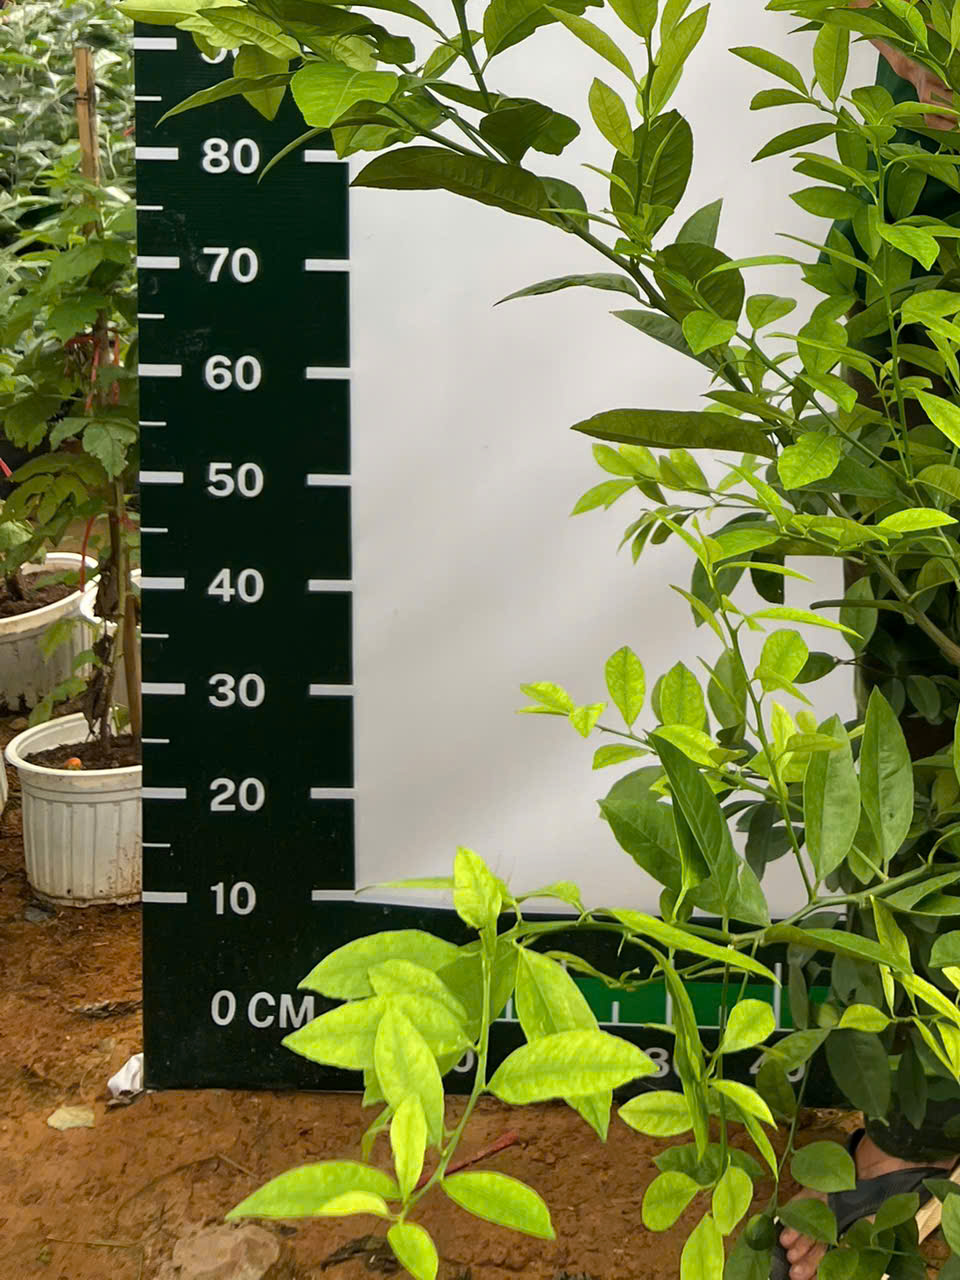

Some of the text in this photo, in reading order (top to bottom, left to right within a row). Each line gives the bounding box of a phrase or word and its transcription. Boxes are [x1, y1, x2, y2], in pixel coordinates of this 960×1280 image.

[203, 138, 259, 173] 80
[203, 248, 258, 282] 70
[206, 355, 261, 390] 60
[208, 463, 263, 496] 50
[209, 569, 263, 602] 40
[210, 674, 264, 706] 30
[211, 778, 264, 810] 20
[211, 882, 255, 914] 10
[212, 991, 313, 1028] 0 CM
